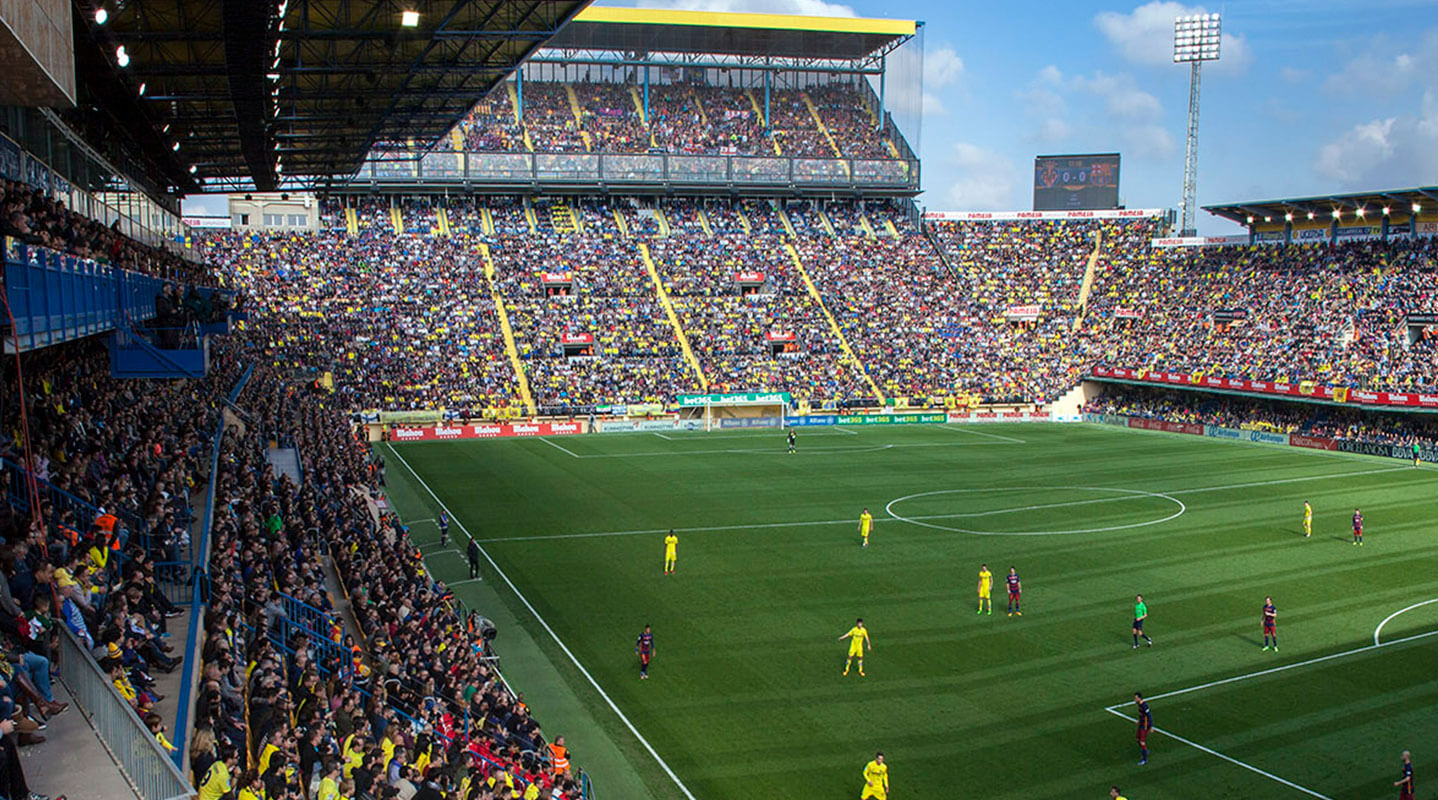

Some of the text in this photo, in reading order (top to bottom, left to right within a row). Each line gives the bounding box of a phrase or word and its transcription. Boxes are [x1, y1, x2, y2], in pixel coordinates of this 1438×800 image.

[838, 416, 862, 424] bet365
[866, 416, 890, 424] bet365
[396, 423, 576, 438] Mahou Mahou Mahou Mahou Mahou
[1338, 441, 1389, 456] PORCELANOSA
[1392, 446, 1414, 459] BBVA
